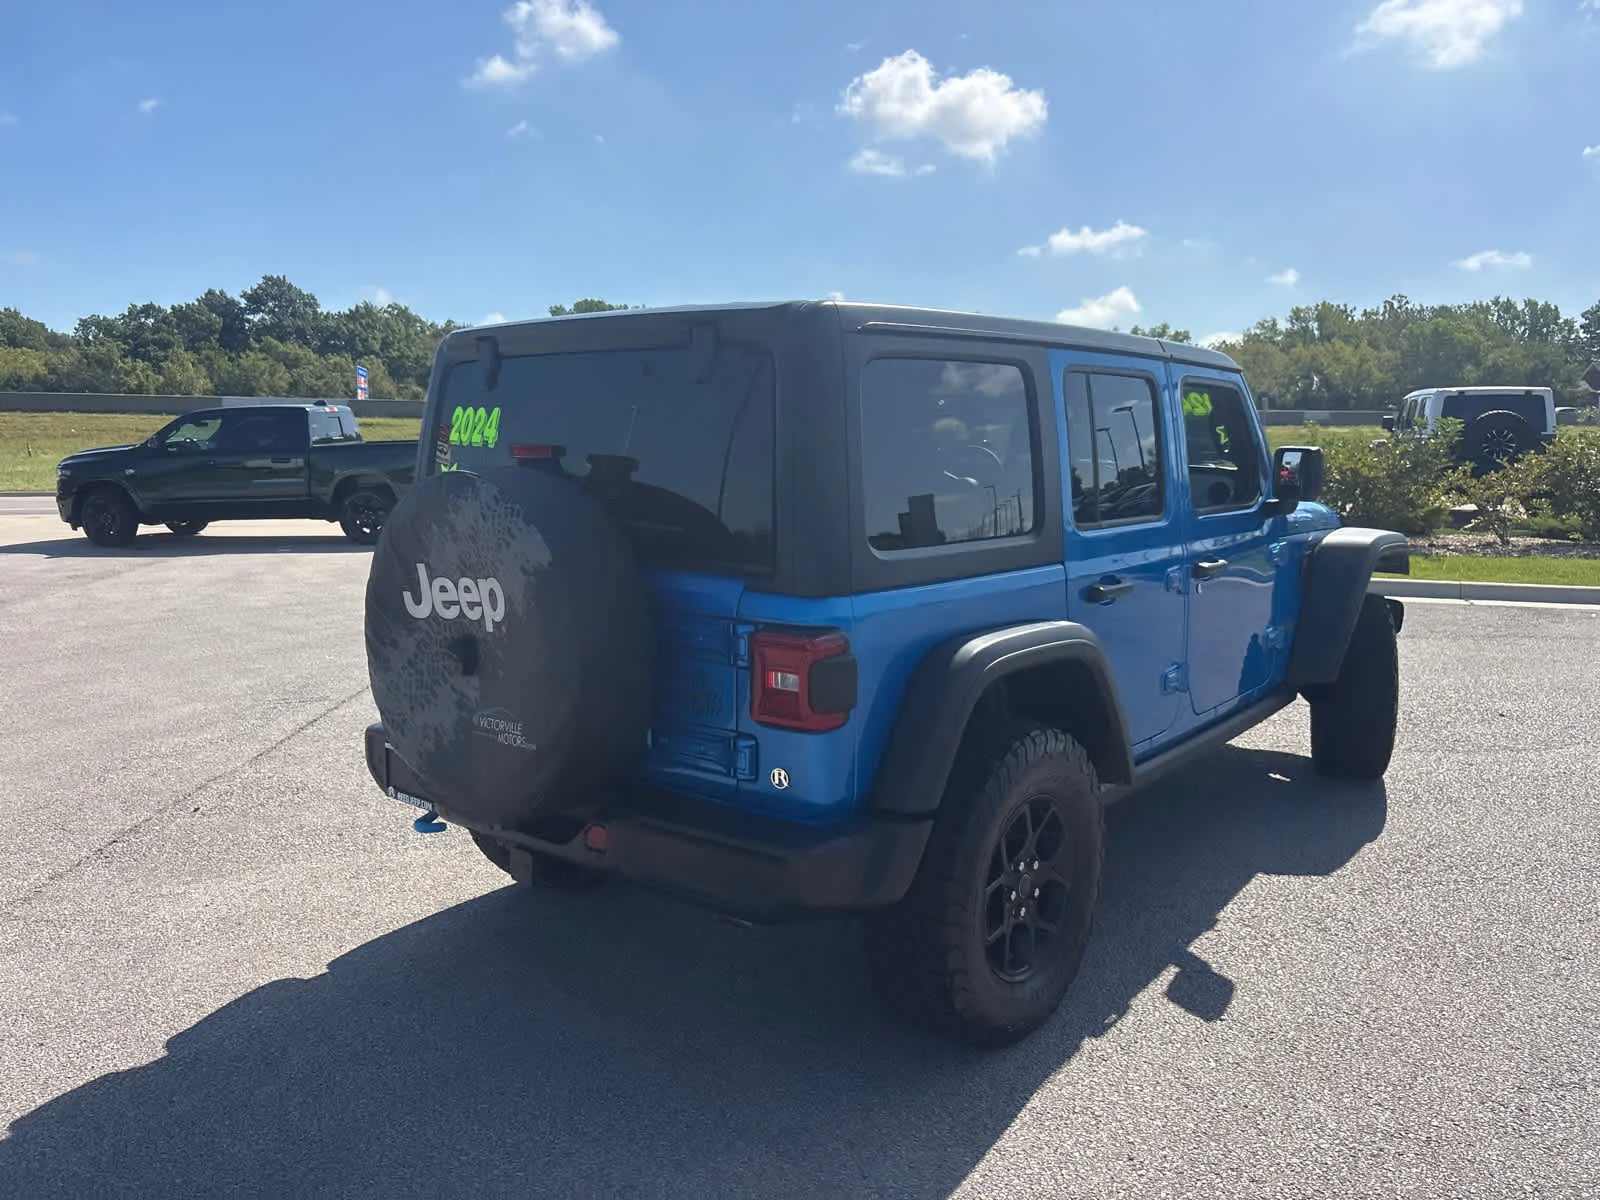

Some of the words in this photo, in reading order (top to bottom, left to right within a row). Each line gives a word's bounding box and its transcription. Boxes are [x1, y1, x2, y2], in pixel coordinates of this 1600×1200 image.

[449, 406, 501, 448] 2024
[403, 563, 506, 632] Jeep
[479, 717, 523, 735] VICTORVILLE
[498, 732, 527, 747] MOTORS
